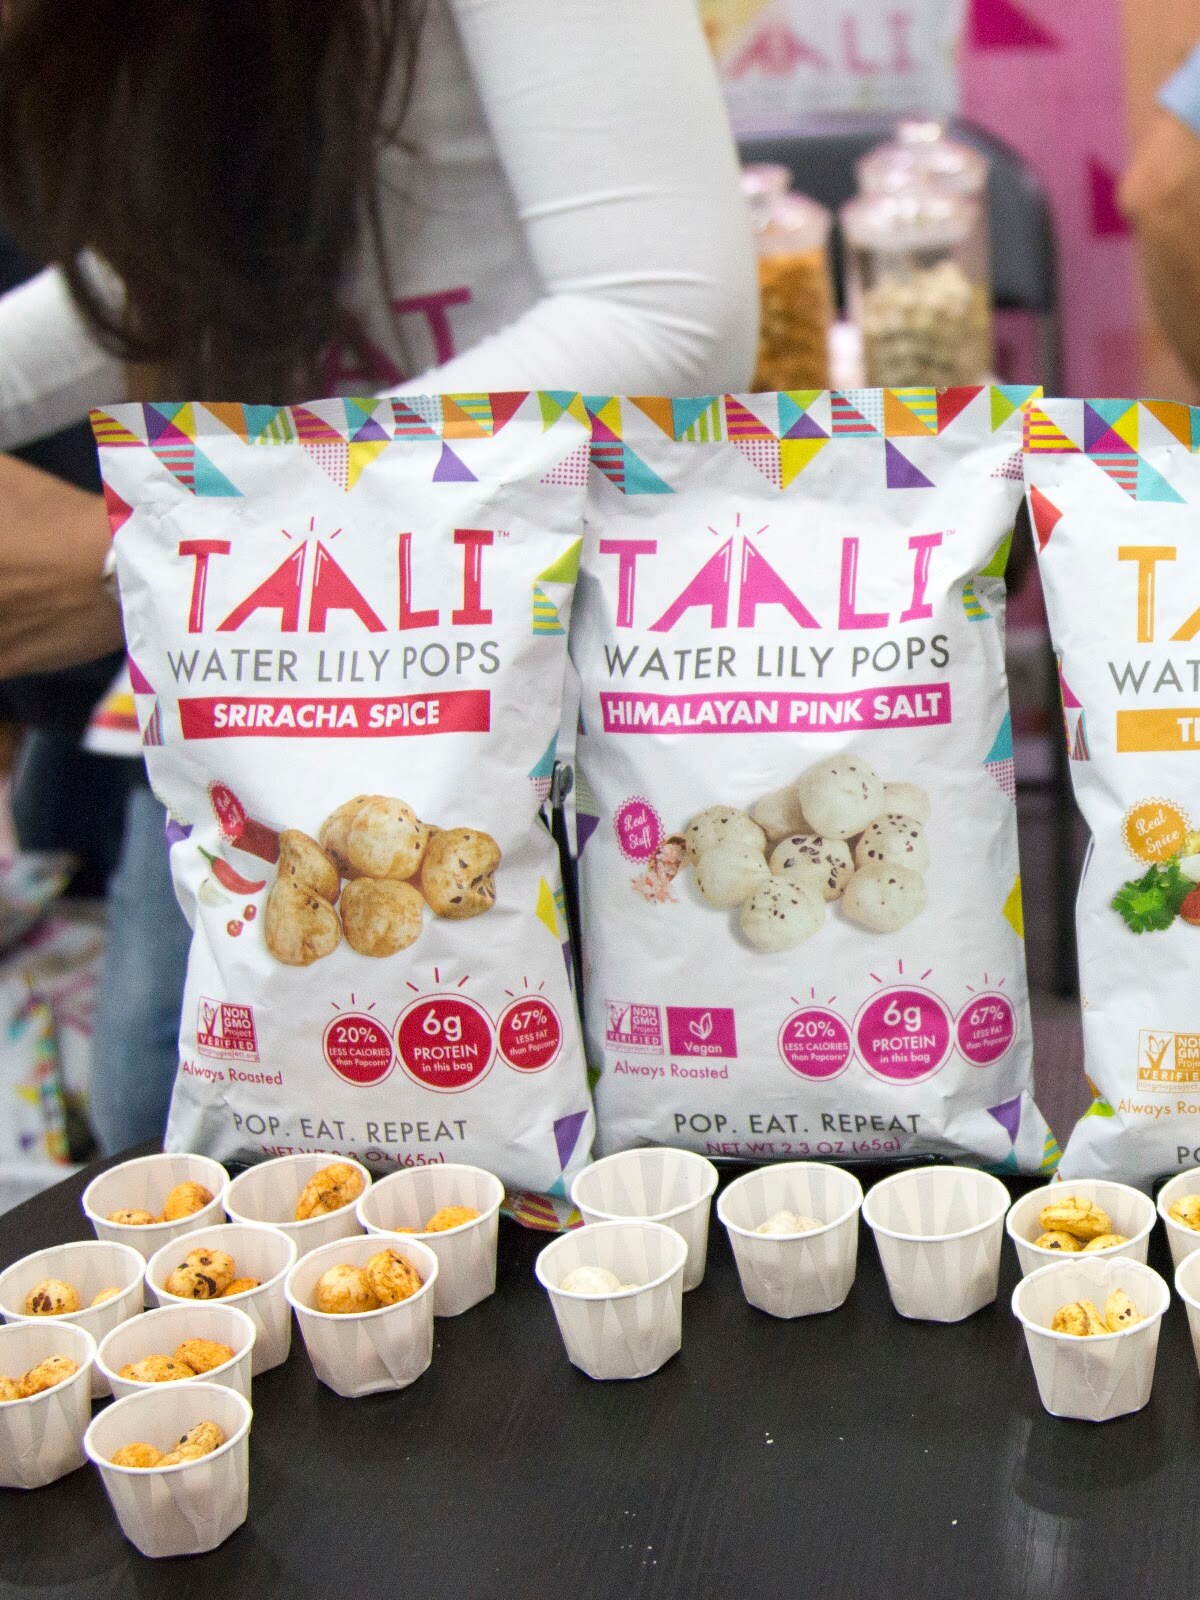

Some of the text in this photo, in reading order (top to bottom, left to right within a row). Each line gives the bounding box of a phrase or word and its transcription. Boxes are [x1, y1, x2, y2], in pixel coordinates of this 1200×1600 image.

[167, 640, 500, 683] WATER LILY POPS
[604, 634, 950, 681] WATER LILY POPS
[213, 701, 440, 729] SRIRACHA SPICE
[607, 692, 941, 726] HIMALAYAN PINK SALT
[1136, 809, 1166, 836] Real
[1146, 830, 1180, 856] Spice
[223, 1007, 248, 1019] NON
[511, 1008, 547, 1031] 67%
[632, 1007, 656, 1017] NON
[883, 1000, 922, 1032] 6g
[970, 1005, 1004, 1025] 67%
[224, 1019, 252, 1029] GMO
[422, 1008, 462, 1042] 6g
[633, 1016, 658, 1026] GMO
[794, 1021, 836, 1037] 20%
[224, 1027, 252, 1038] Project
[336, 1026, 377, 1043] 20%
[516, 1030, 548, 1044] LESS FAT
[609, 1032, 659, 1045] VERIFIED
[200, 1034, 254, 1051] VERIFIED
[684, 1041, 722, 1055] Vegan
[785, 1042, 848, 1050] LESS CALORIES
[872, 1035, 936, 1052] PROTEIN
[329, 1047, 391, 1056] LESS CALORIES
[413, 1043, 478, 1060] PROTEIN
[791, 1053, 808, 1061] than
[880, 1052, 930, 1063] in this bag
[336, 1058, 352, 1066] than
[422, 1060, 473, 1073] in this bag
[614, 1060, 728, 1079] Always Roasted
[183, 1060, 283, 1085] Always Roasted
[1118, 1097, 1171, 1119] Always
[232, 1112, 467, 1144] POP. EAT. REPEAT
[674, 1112, 920, 1134] POP. EAT. REPEAT
[705, 1141, 741, 1154] NET
[745, 1142, 775, 1154] WT
[817, 1141, 846, 1155] OZ
[852, 1136, 901, 1154] (65g)
